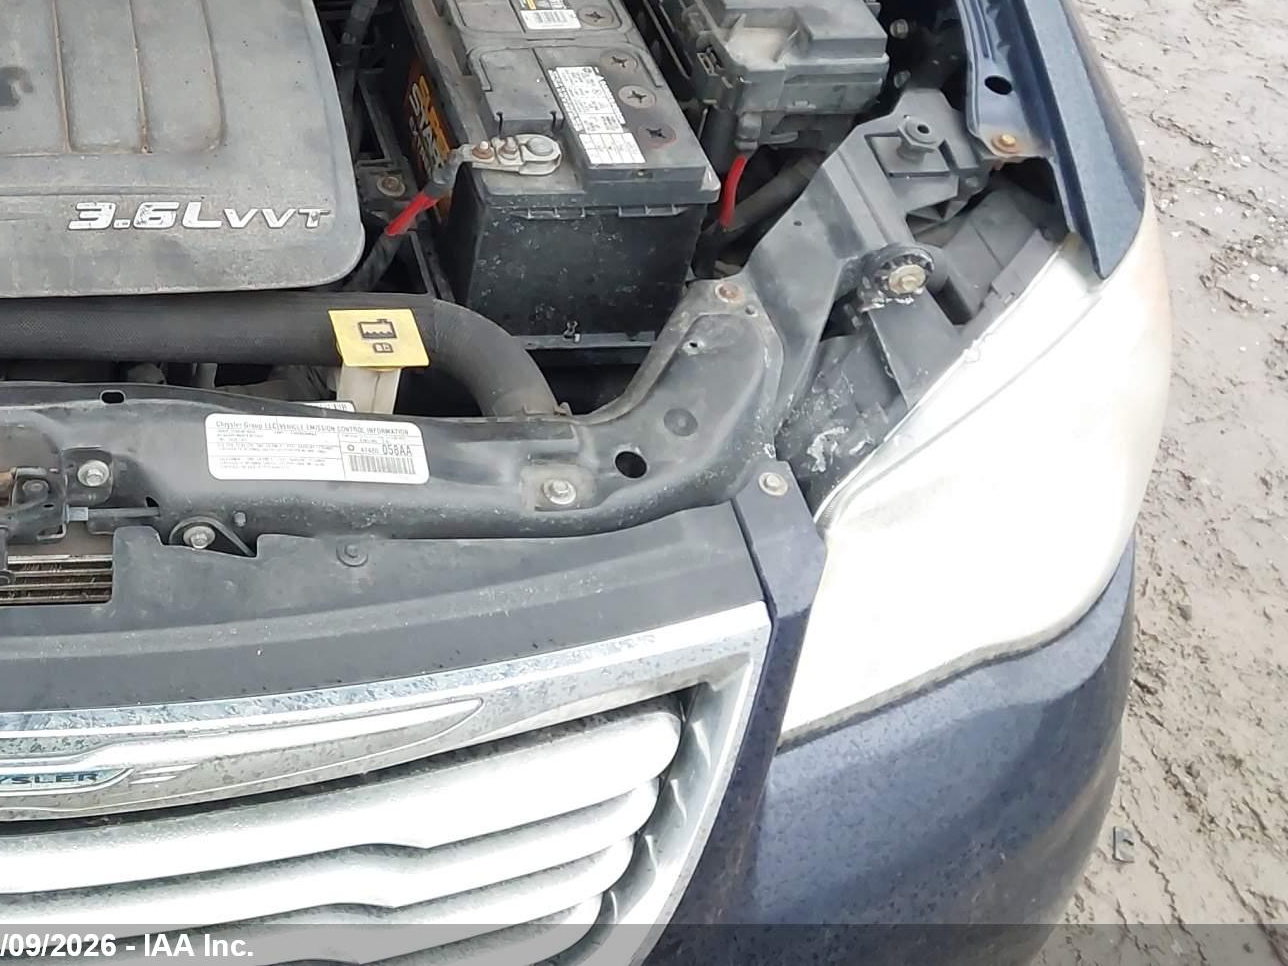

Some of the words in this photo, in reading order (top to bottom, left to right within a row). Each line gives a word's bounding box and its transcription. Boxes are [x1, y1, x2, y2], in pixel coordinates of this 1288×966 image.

[68, 202, 223, 230] 3.6L
[223, 208, 332, 229] VVT
[216, 421, 241, 430] Chrysler
[243, 422, 262, 430] Group
